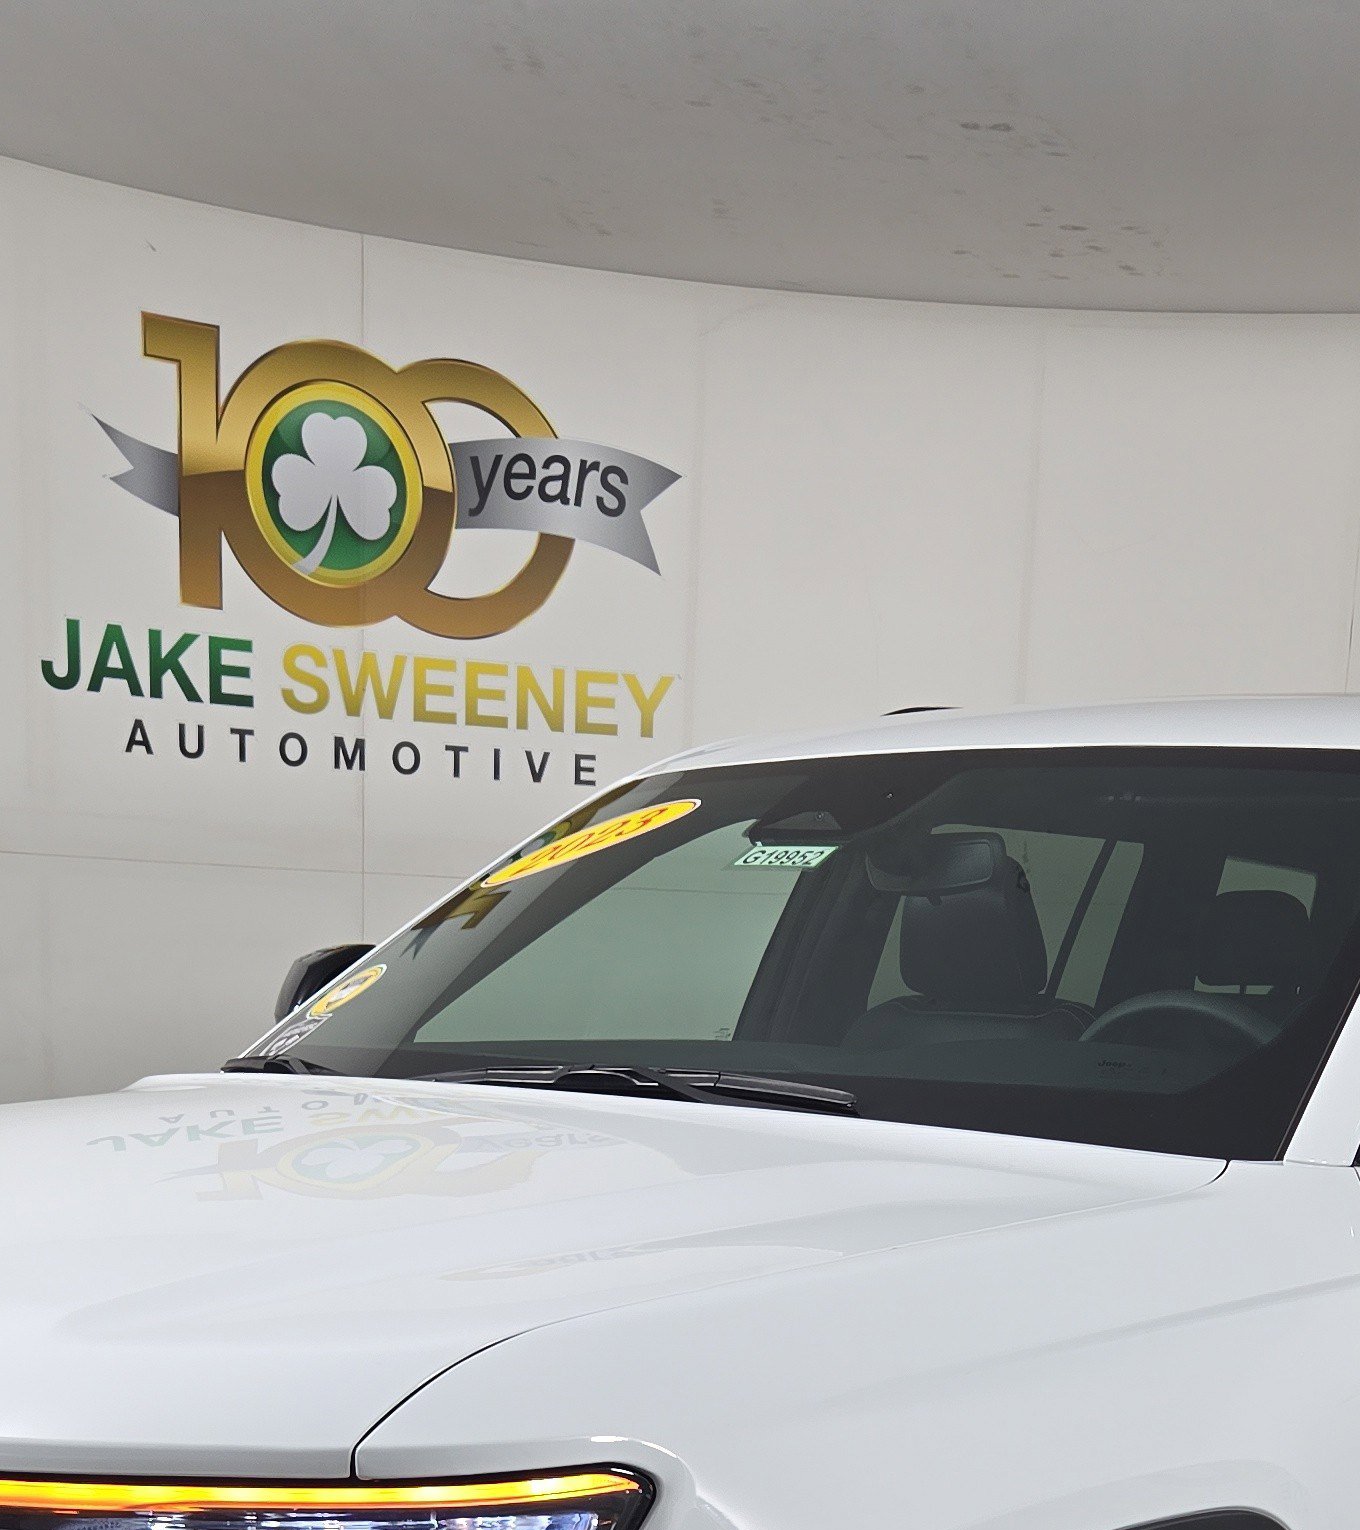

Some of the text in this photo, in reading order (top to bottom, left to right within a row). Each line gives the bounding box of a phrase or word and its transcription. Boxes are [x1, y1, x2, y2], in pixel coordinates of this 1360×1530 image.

[140, 310, 631, 640] 100 years
[40, 617, 676, 739] JAKE SWEENEY
[125, 717, 598, 787] AUTOMOTIVE
[508, 807, 670, 879] 2023
[742, 849, 825, 866] G19952
